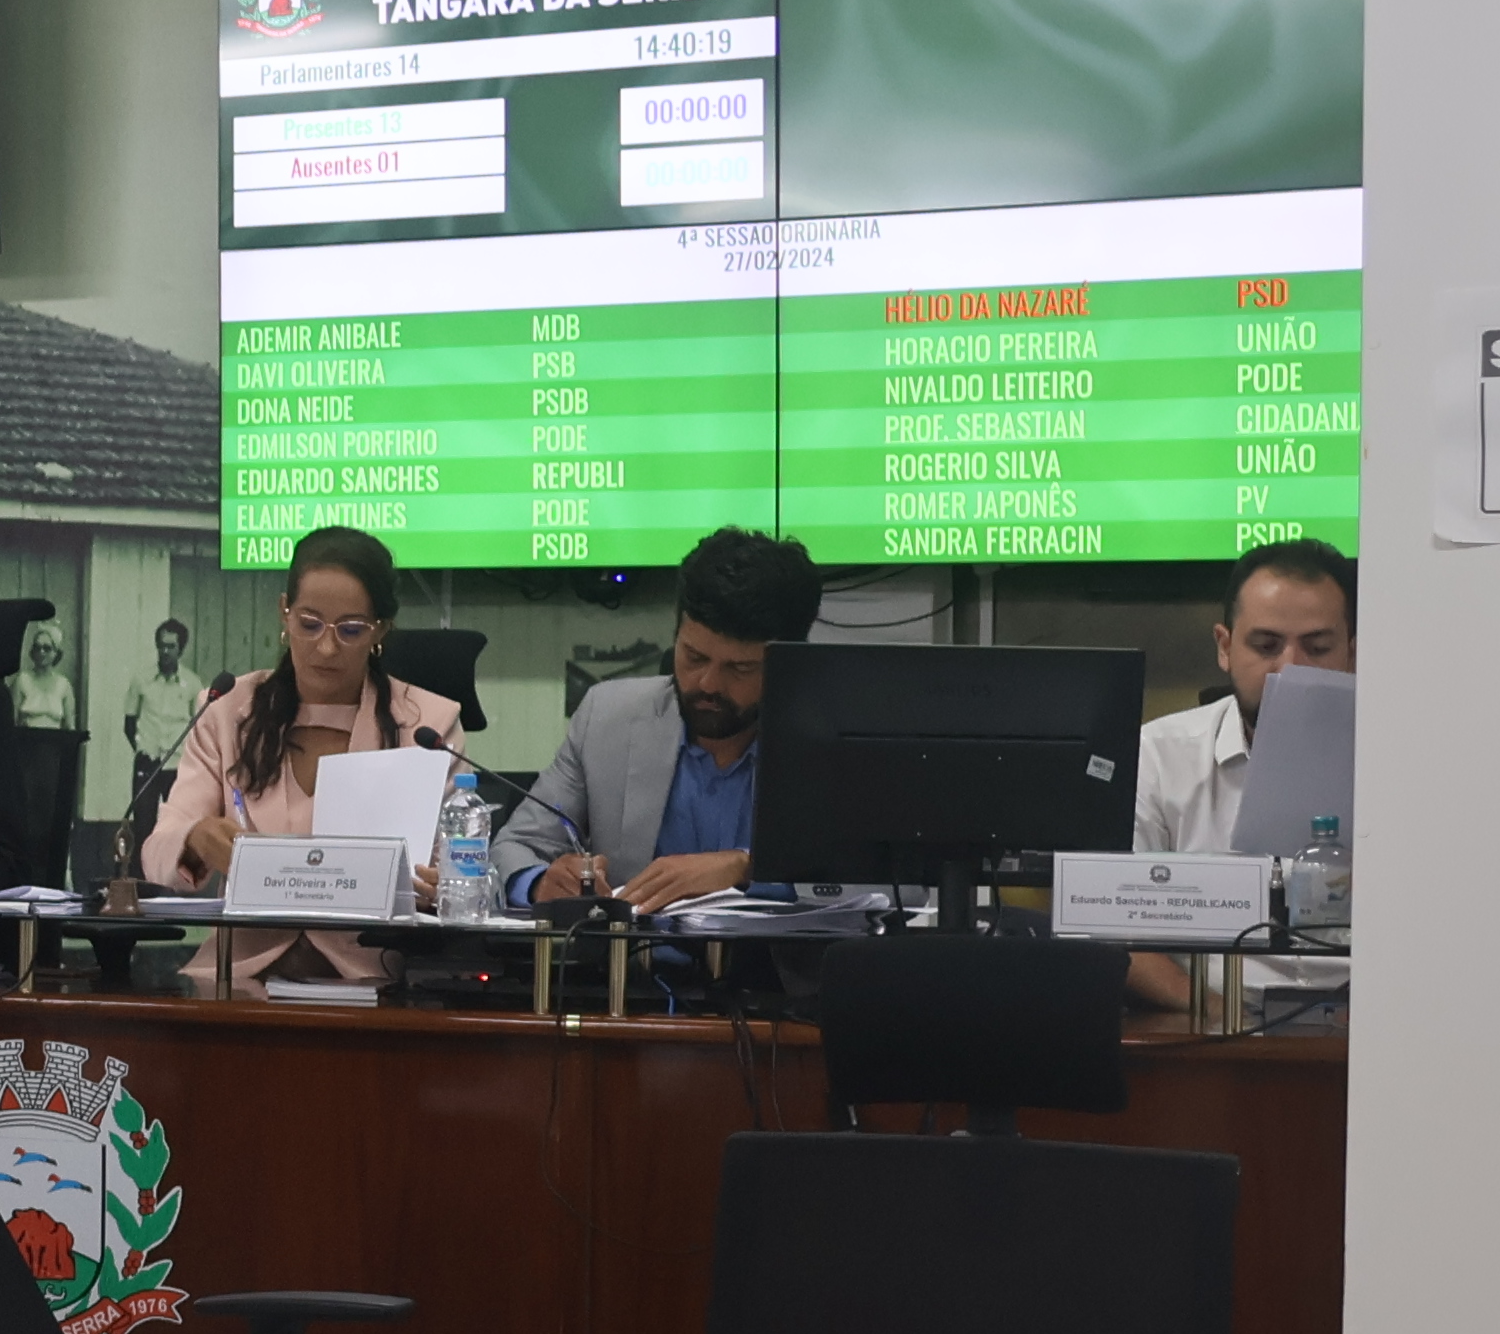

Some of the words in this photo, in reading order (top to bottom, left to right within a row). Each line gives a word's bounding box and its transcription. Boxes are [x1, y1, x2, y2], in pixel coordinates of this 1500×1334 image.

[633, 28, 733, 61] 14:40:19
[260, 56, 392, 87] Parlamentares
[399, 53, 420, 76] 14
[643, 94, 748, 126] 00:00:00
[283, 115, 374, 142] Presentes
[380, 111, 403, 135] 13
[290, 155, 373, 179] Ausentes
[377, 151, 401, 175] 01
[645, 155, 749, 187] 00:00:00
[677, 229, 698, 249] 4ª
[724, 247, 835, 273] 27/02/2024
[885, 289, 952, 324] HÉLIO
[959, 291, 991, 322] DA
[999, 280, 1091, 320] NAZARÉ
[1237, 277, 1289, 309] PSD
[237, 325, 312, 354] ADEMIR
[318, 321, 402, 351] ANIBALE
[532, 313, 580, 342] MDB
[1236, 316, 1317, 353] UNIÃO
[885, 333, 992, 366] HORACIO
[999, 329, 1098, 361] PEREIRA
[237, 362, 284, 389] DAVI
[290, 358, 385, 387] OLIVEIRA
[532, 351, 576, 379] PSB
[1236, 362, 1303, 394] PODE
[532, 387, 589, 416] PSDB
[885, 373, 984, 405] NIVALDO
[991, 369, 1094, 402] LEITEIRO
[237, 397, 292, 425] DONA
[297, 394, 354, 423] NEIDE
[1236, 401, 1361, 433] CIDADANI
[532, 424, 588, 452] PODE
[885, 414, 949, 443] PROF.
[956, 409, 1085, 441] SEBASTIAN
[237, 431, 337, 460] EDMILSON
[343, 428, 438, 457] PORFIRIO
[1236, 438, 1316, 474] UNIÃO
[237, 467, 335, 496] EDUARDO
[341, 464, 440, 493] SANCHES
[532, 460, 625, 490] REPUBLI
[885, 449, 988, 482] ROGERIO
[994, 448, 1062, 480] SILVA
[532, 498, 590, 526] PODE
[885, 488, 967, 521] ROMER
[973, 481, 1077, 519] JAPONÊS
[1236, 484, 1270, 515] PV
[237, 503, 306, 531] ELAINE
[311, 502, 407, 529] ANTUNES
[237, 535, 293, 563] FABIO
[532, 532, 589, 561] PSDB
[884, 525, 978, 557] SANDRA
[986, 523, 1102, 555] FERRACIN
[264, 876, 286, 888] Davi
[288, 877, 326, 889] Oliveira
[335, 878, 357, 890] PSB
[1070, 895, 1112, 905] Eduardo
[1115, 895, 1158, 906] Sanches
[1167, 897, 1251, 910] REPUBLICANOS
[128, 1298, 168, 1316] 1976
